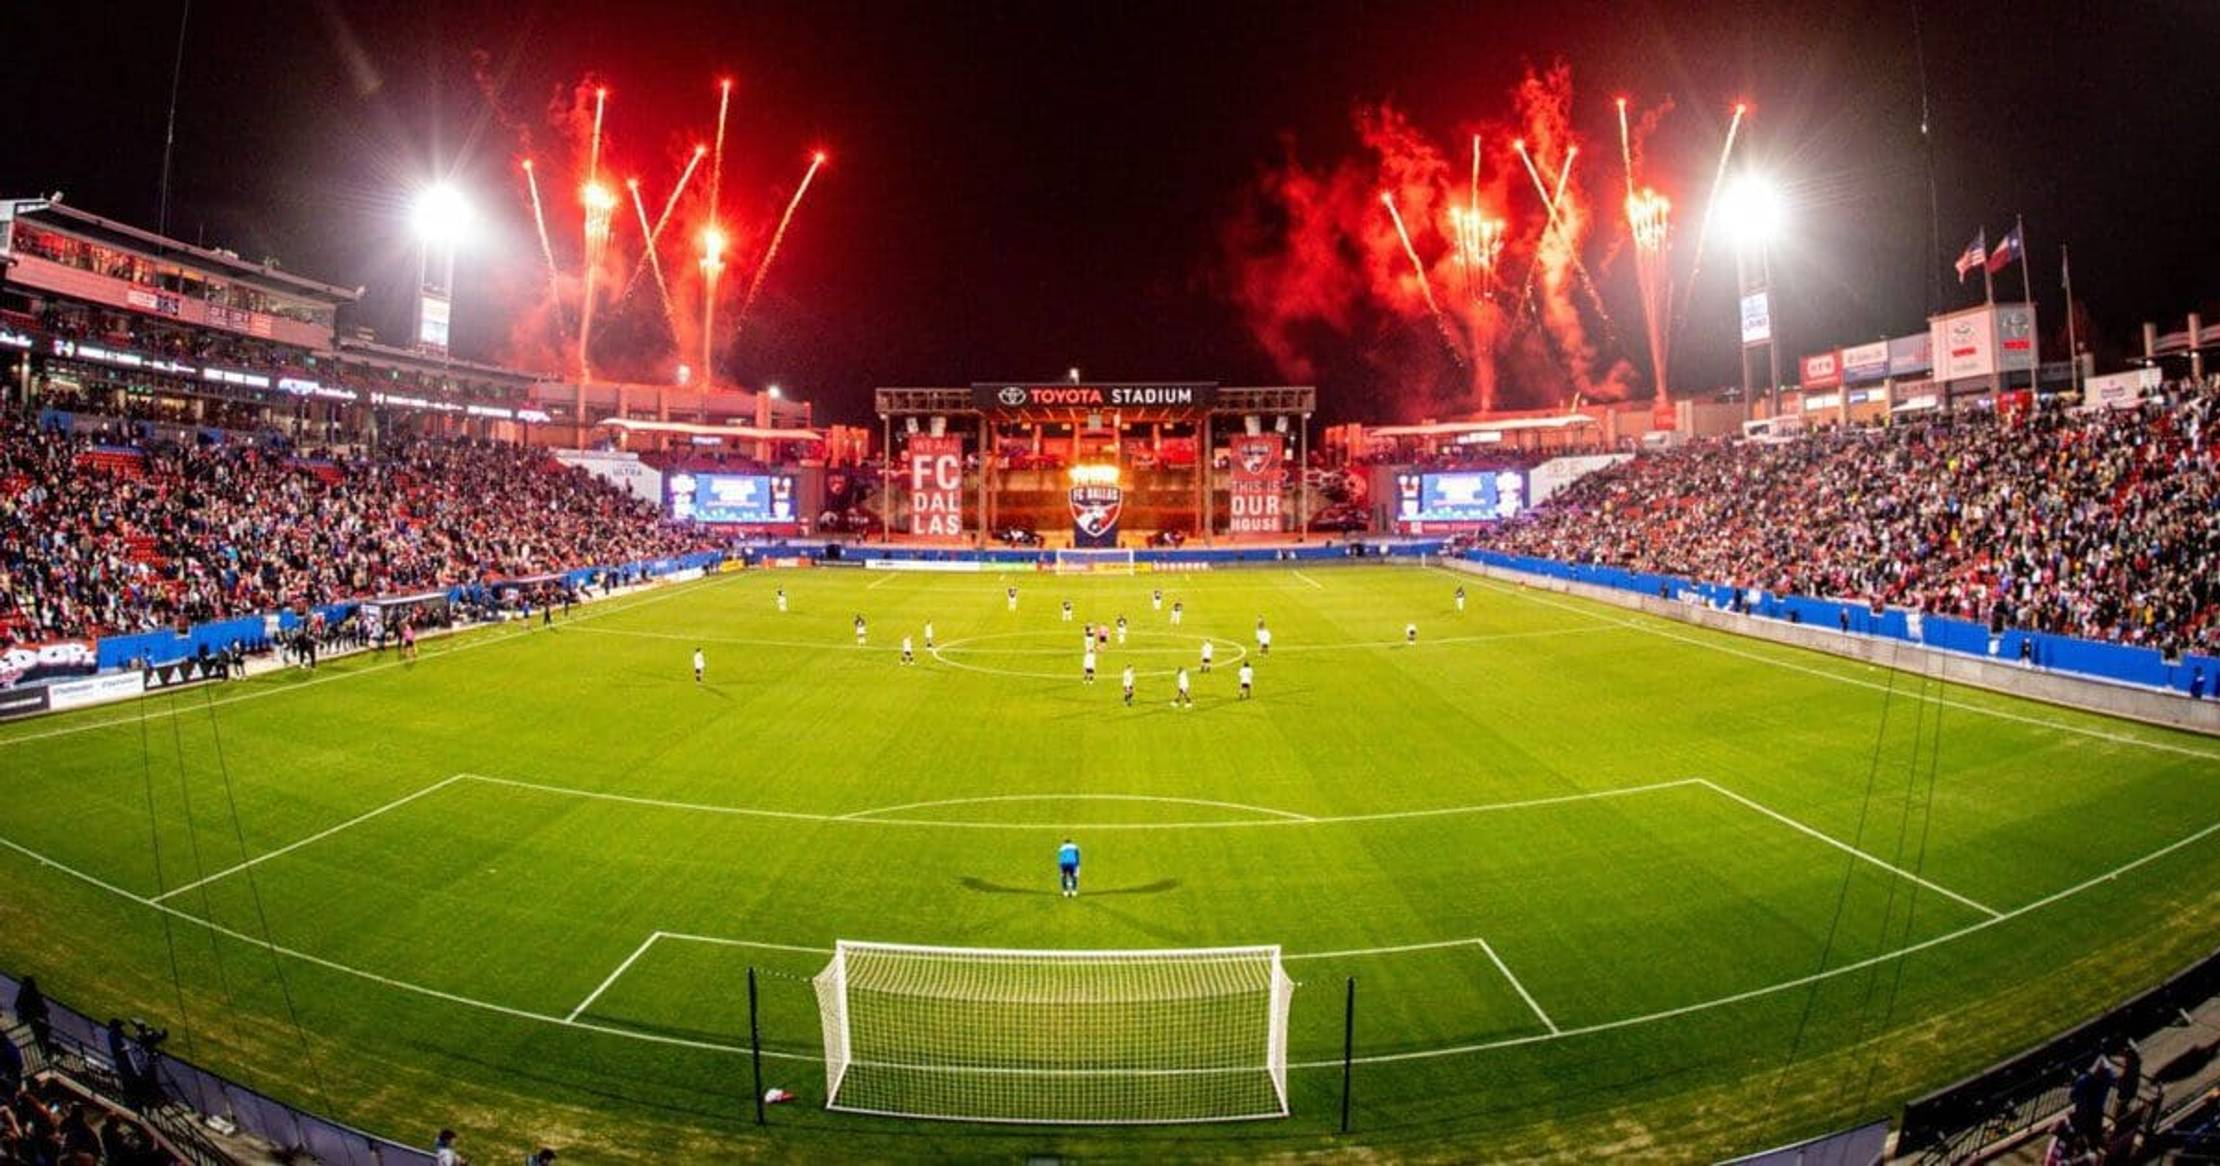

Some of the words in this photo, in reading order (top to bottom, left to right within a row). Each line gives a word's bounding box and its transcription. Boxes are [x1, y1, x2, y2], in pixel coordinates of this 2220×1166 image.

[1031, 388, 1103, 404] TOYOTA
[1111, 388, 1192, 404] STADIUM
[913, 454, 960, 491] FC
[1073, 487, 1084, 501] FC
[1087, 486, 1119, 501] DALLAS
[1267, 480, 1280, 493] IS
[914, 492, 959, 512] DAL
[1231, 495, 1280, 516] OUR
[913, 514, 960, 536] LAS
[1230, 517, 1279, 532] HOUSE
